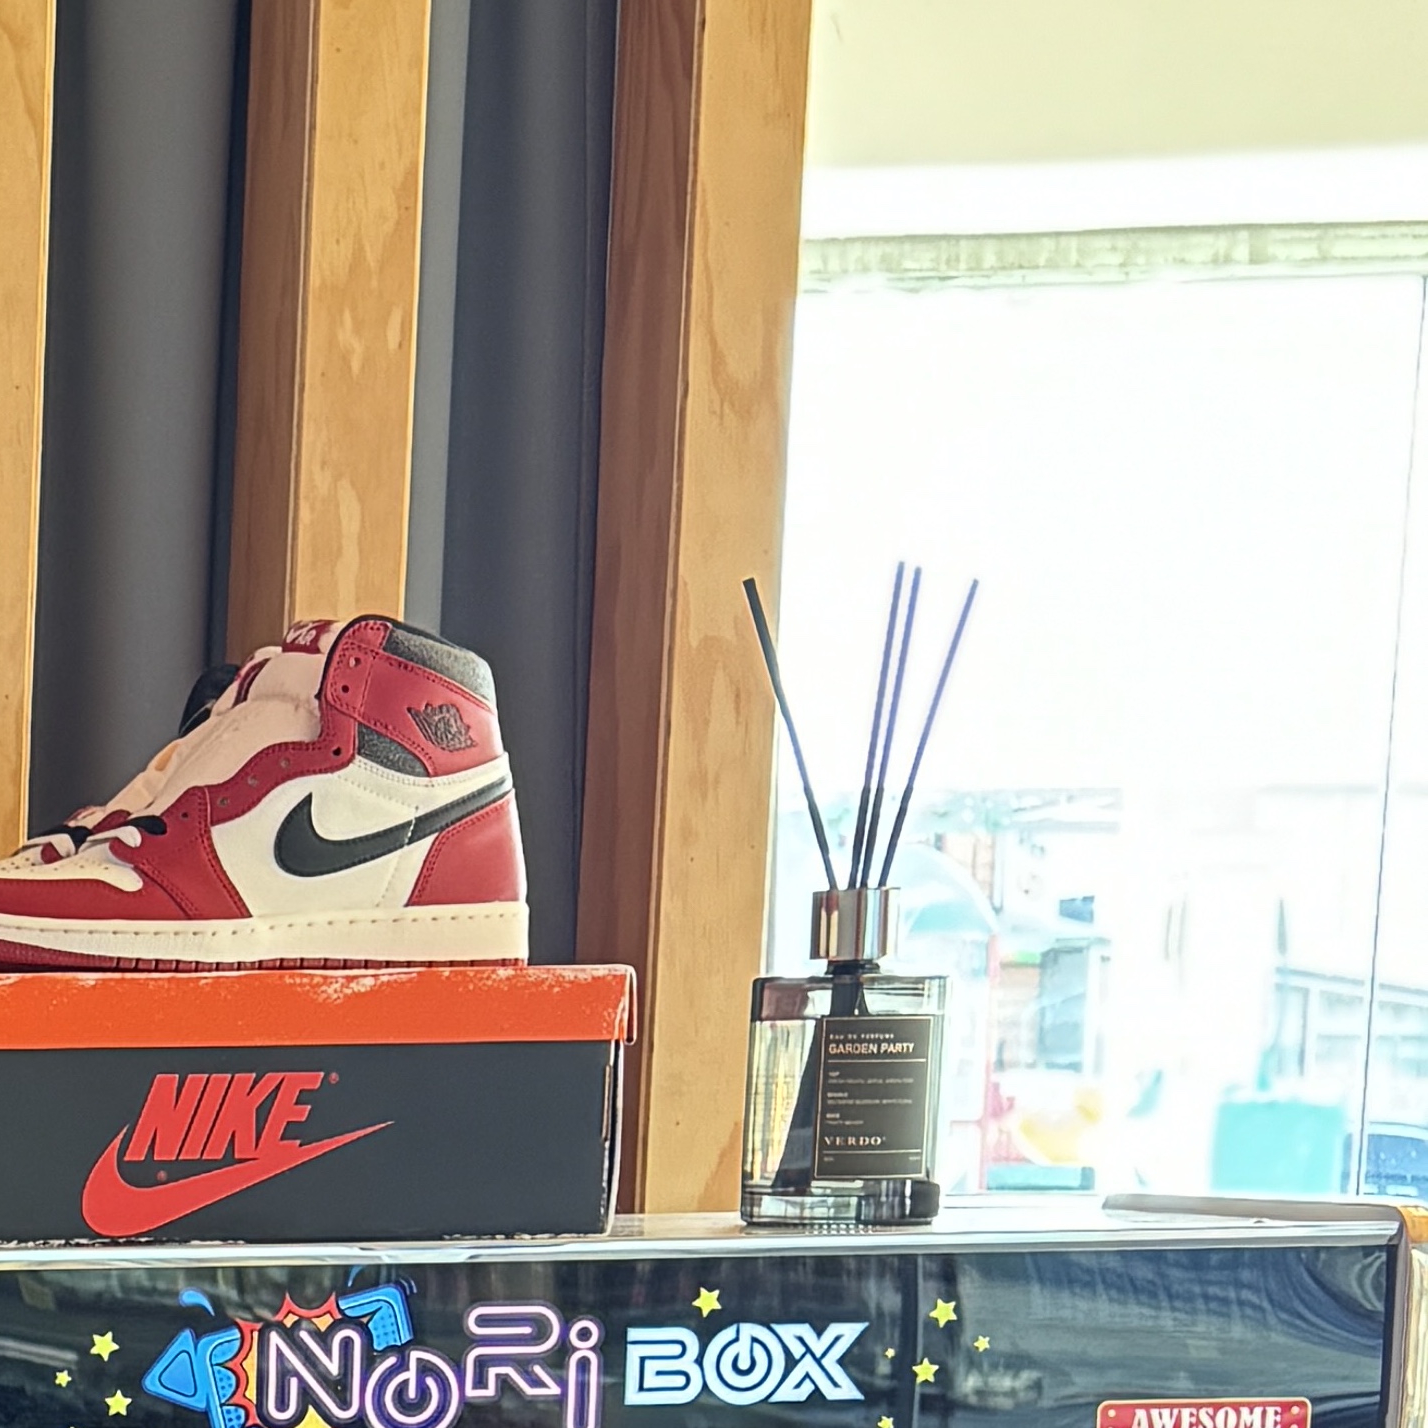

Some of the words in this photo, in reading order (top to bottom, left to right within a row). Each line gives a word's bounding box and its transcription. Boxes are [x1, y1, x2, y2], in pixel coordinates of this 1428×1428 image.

[828, 1042, 878, 1055] GARDEN
[880, 1042, 915, 1054] PARTY
[126, 1071, 325, 1161] NIKE
[824, 1136, 882, 1146] VERDO
[624, 1321, 871, 1406] BOX
